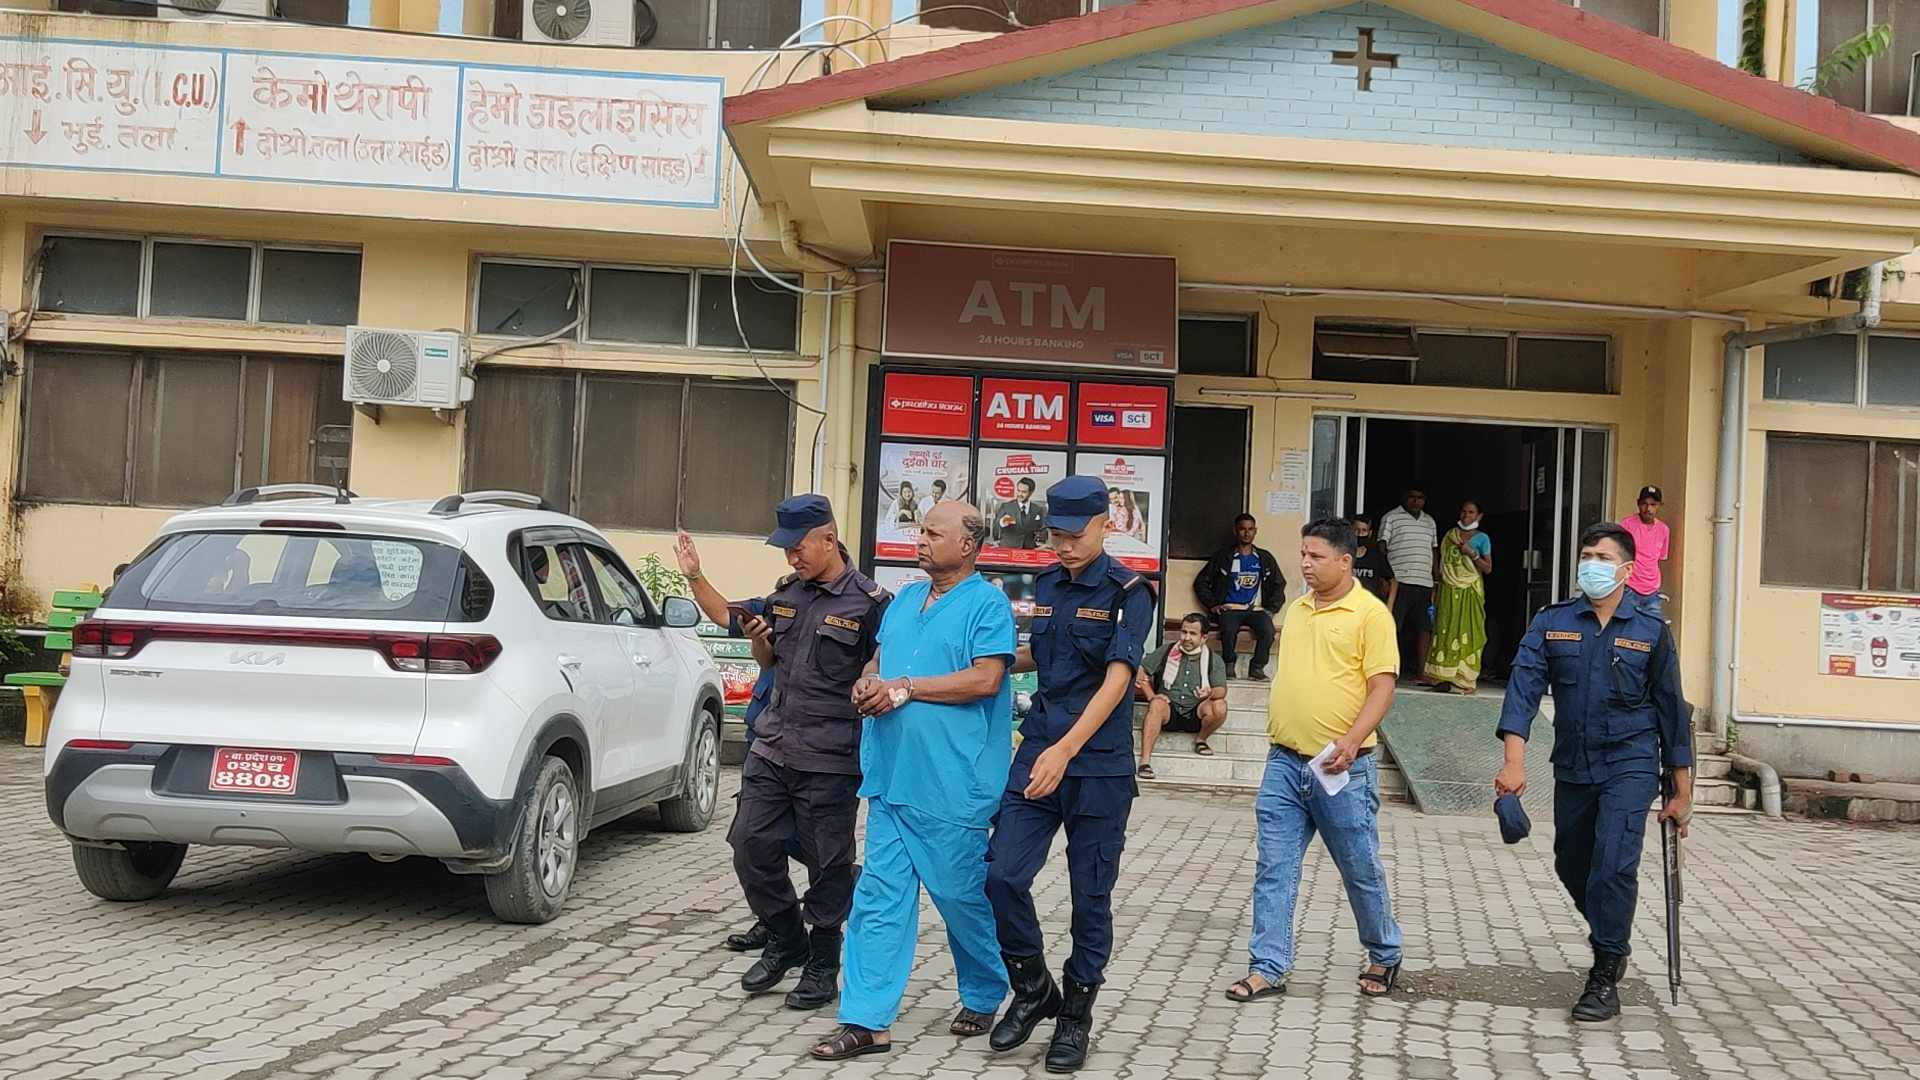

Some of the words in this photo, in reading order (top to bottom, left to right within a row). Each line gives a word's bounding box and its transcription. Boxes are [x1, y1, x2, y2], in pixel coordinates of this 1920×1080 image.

[959, 280, 1105, 331] ATM
[977, 334, 993, 345] 24
[994, 335, 1033, 347] HOURS
[1034, 337, 1085, 349] BANKING
[987, 391, 1063, 421] ATM
[1093, 413, 1116, 424] VISA
